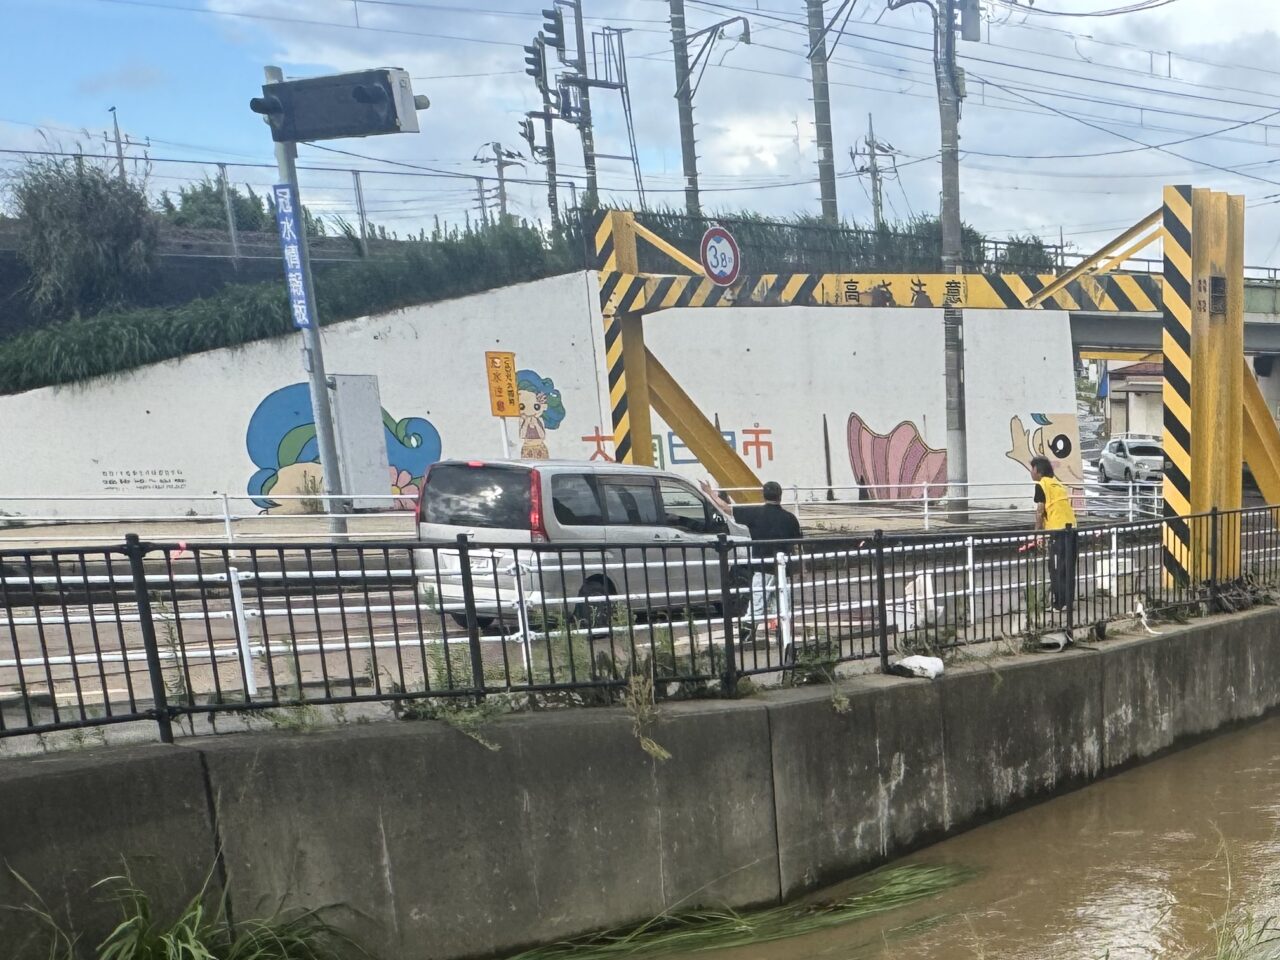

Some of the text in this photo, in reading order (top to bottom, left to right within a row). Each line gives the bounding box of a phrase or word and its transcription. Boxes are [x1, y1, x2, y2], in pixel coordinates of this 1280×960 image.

[275, 187, 310, 325] 冠水情報板
